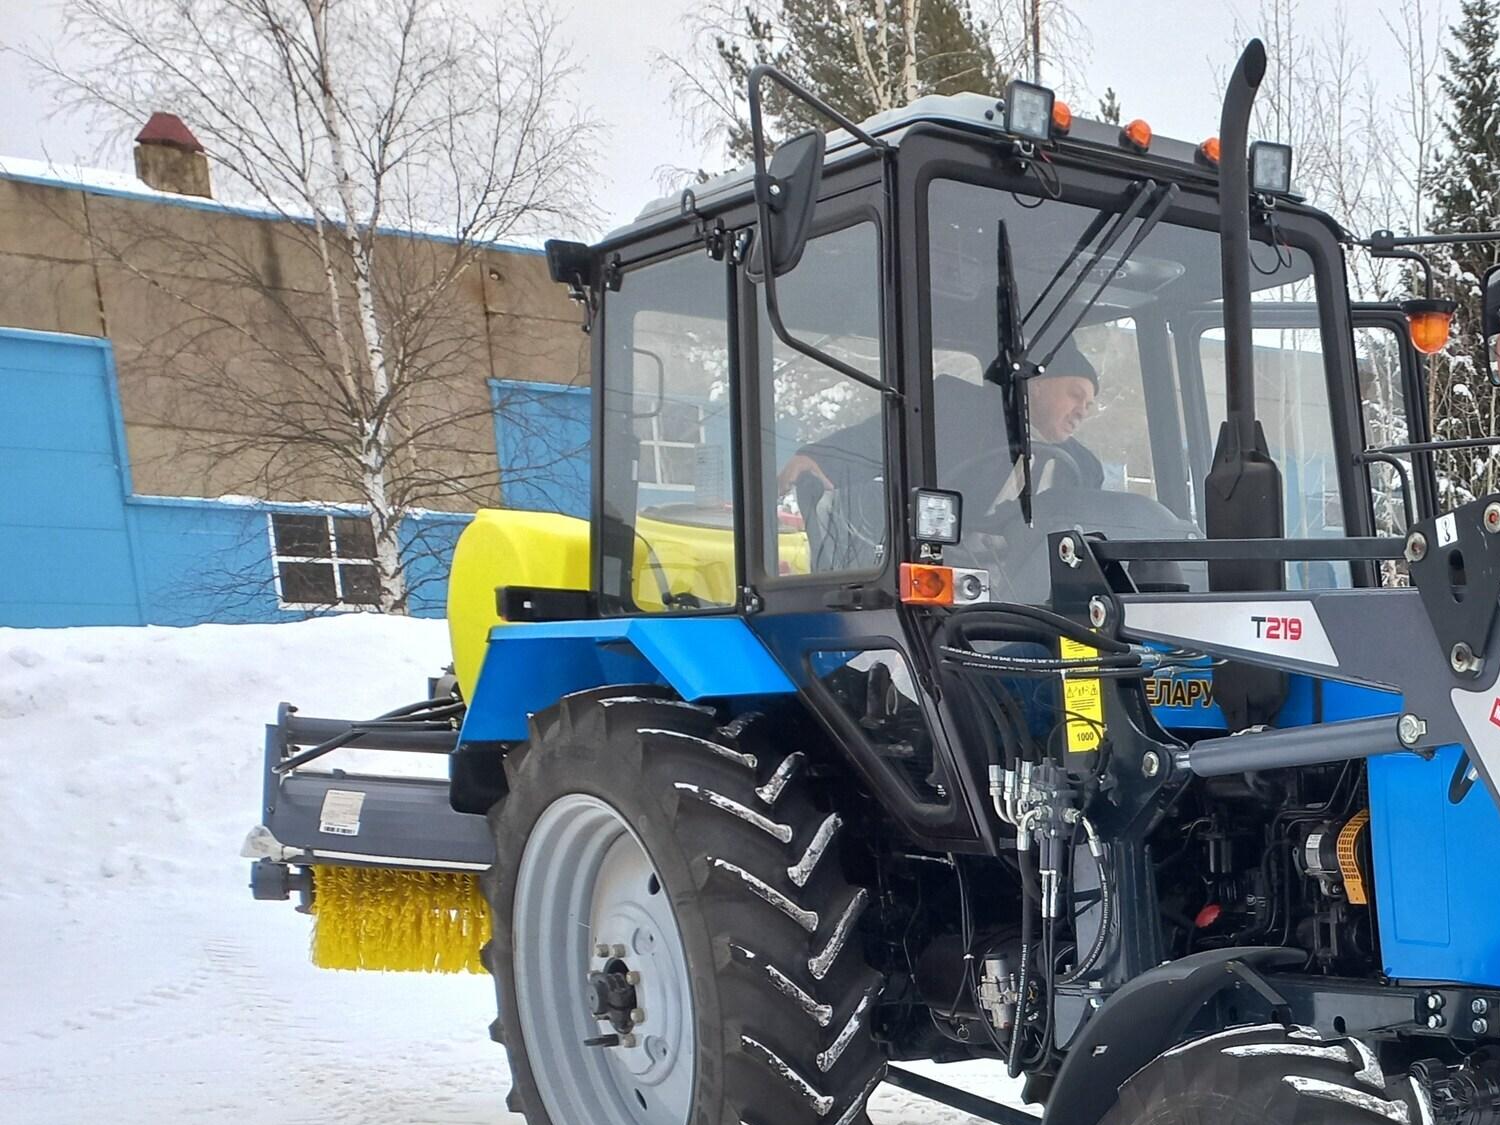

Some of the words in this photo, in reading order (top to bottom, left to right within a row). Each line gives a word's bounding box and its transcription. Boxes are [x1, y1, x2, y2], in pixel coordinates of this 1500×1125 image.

[1250, 615, 1303, 640] T219
[1143, 678, 1214, 708] ЕЛАРУ
[1076, 731, 1095, 742] 1000
